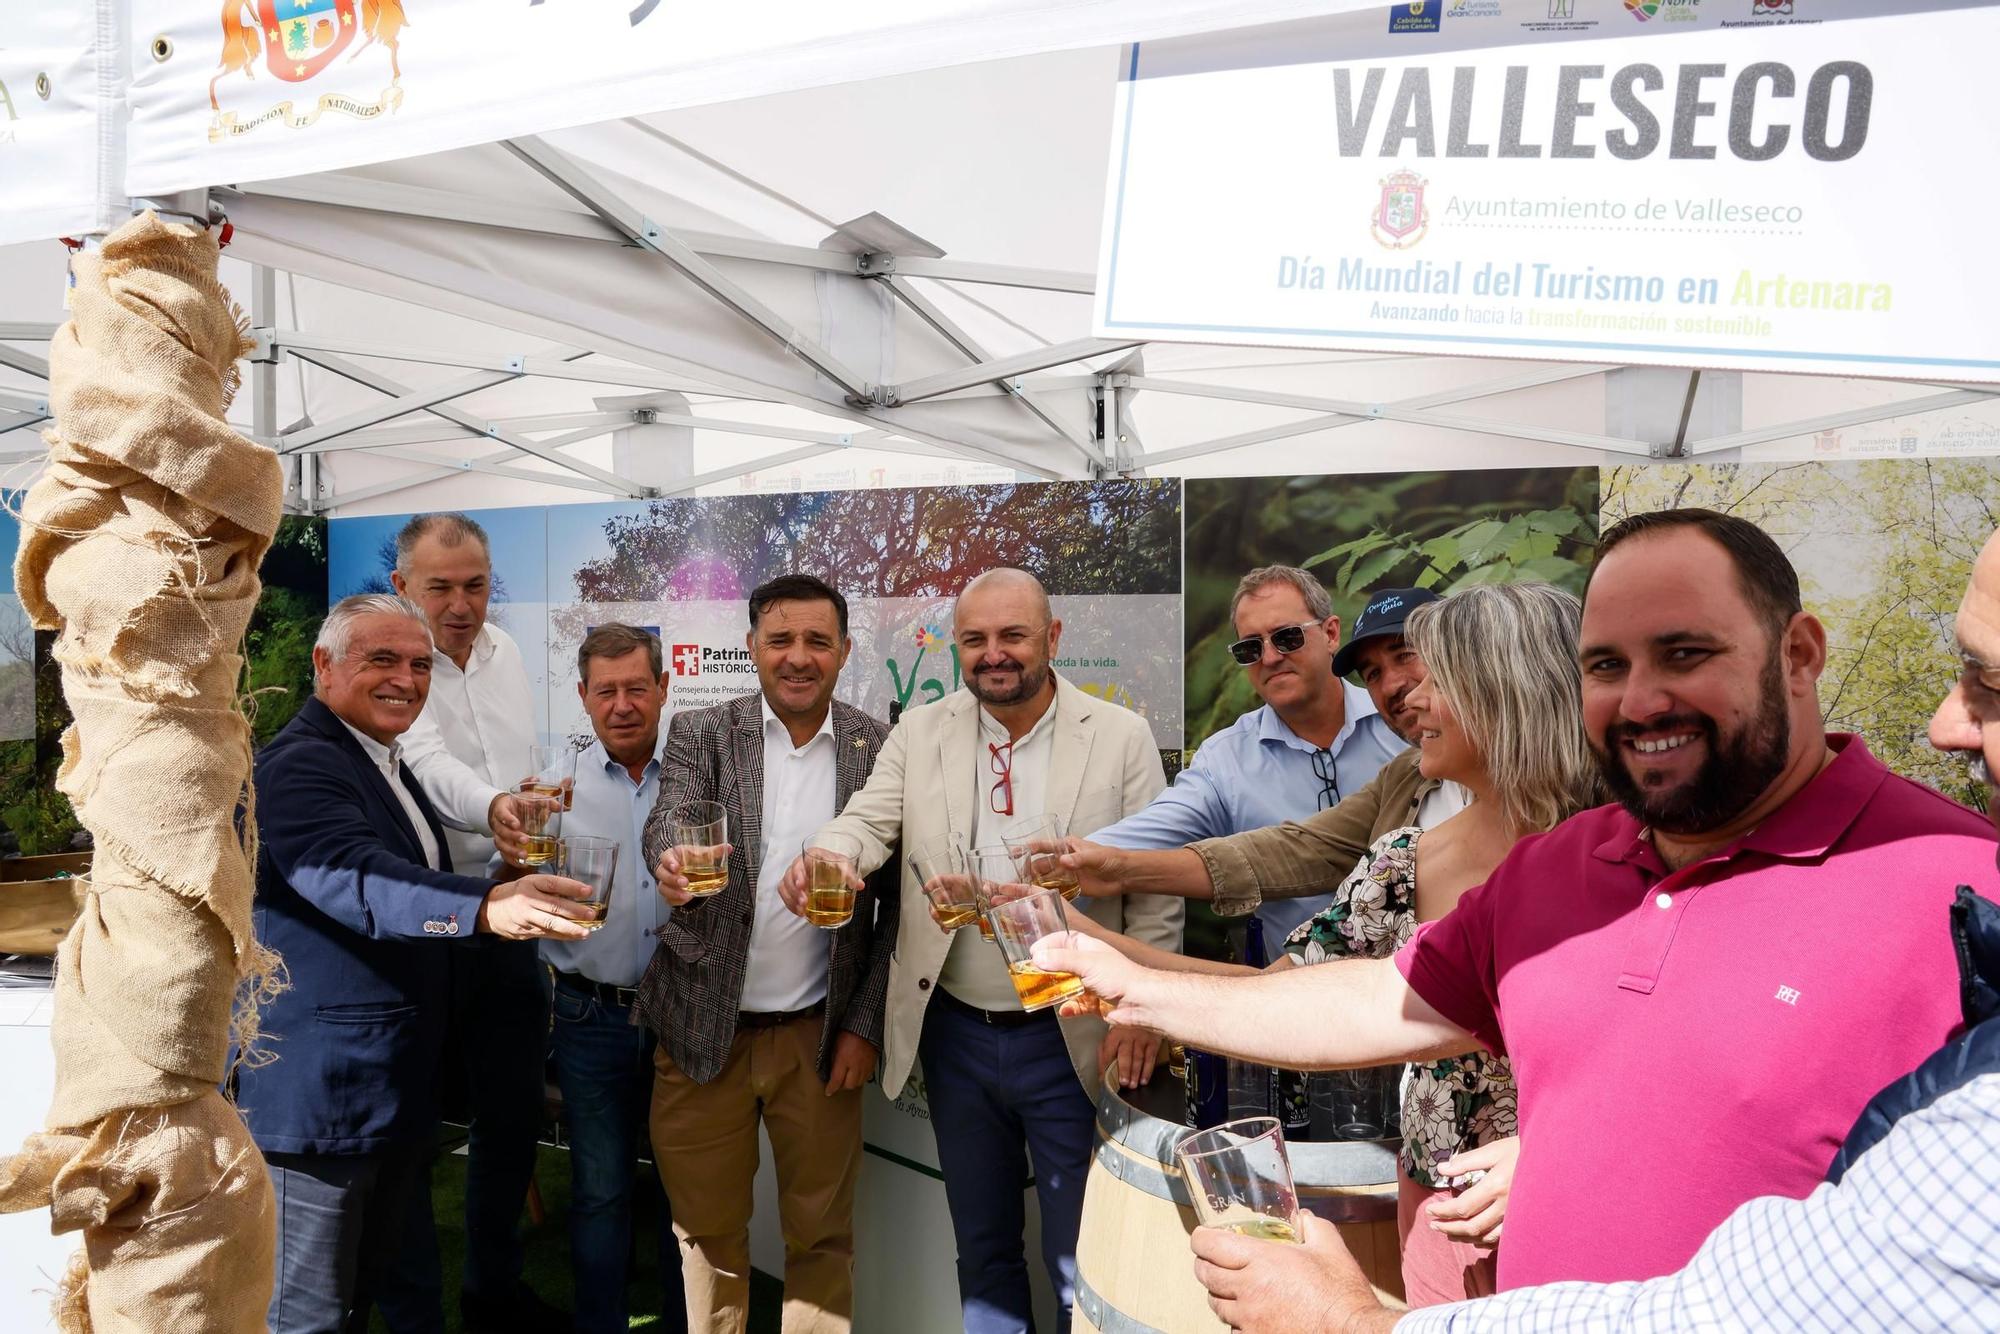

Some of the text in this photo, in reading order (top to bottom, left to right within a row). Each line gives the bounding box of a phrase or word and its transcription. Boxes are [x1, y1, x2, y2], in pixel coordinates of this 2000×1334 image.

[326, 99, 381, 116] NATURALEZA
[1333, 61, 1874, 162] VALLESECO
[1445, 195, 1803, 223] Ayuntamiento de Valleseco
[1277, 255, 1893, 313] Día Mundial del Turismo en Artenara
[1369, 301, 1773, 337] Avanzando hacia la transformación sostenible
[703, 662, 758, 674] HISTÓRICO
[1052, 658, 1120, 668] toda la vida.
[711, 685, 720, 694] de
[679, 698, 714, 706] Movilidad
[1206, 1192, 1246, 1209] GRAN
